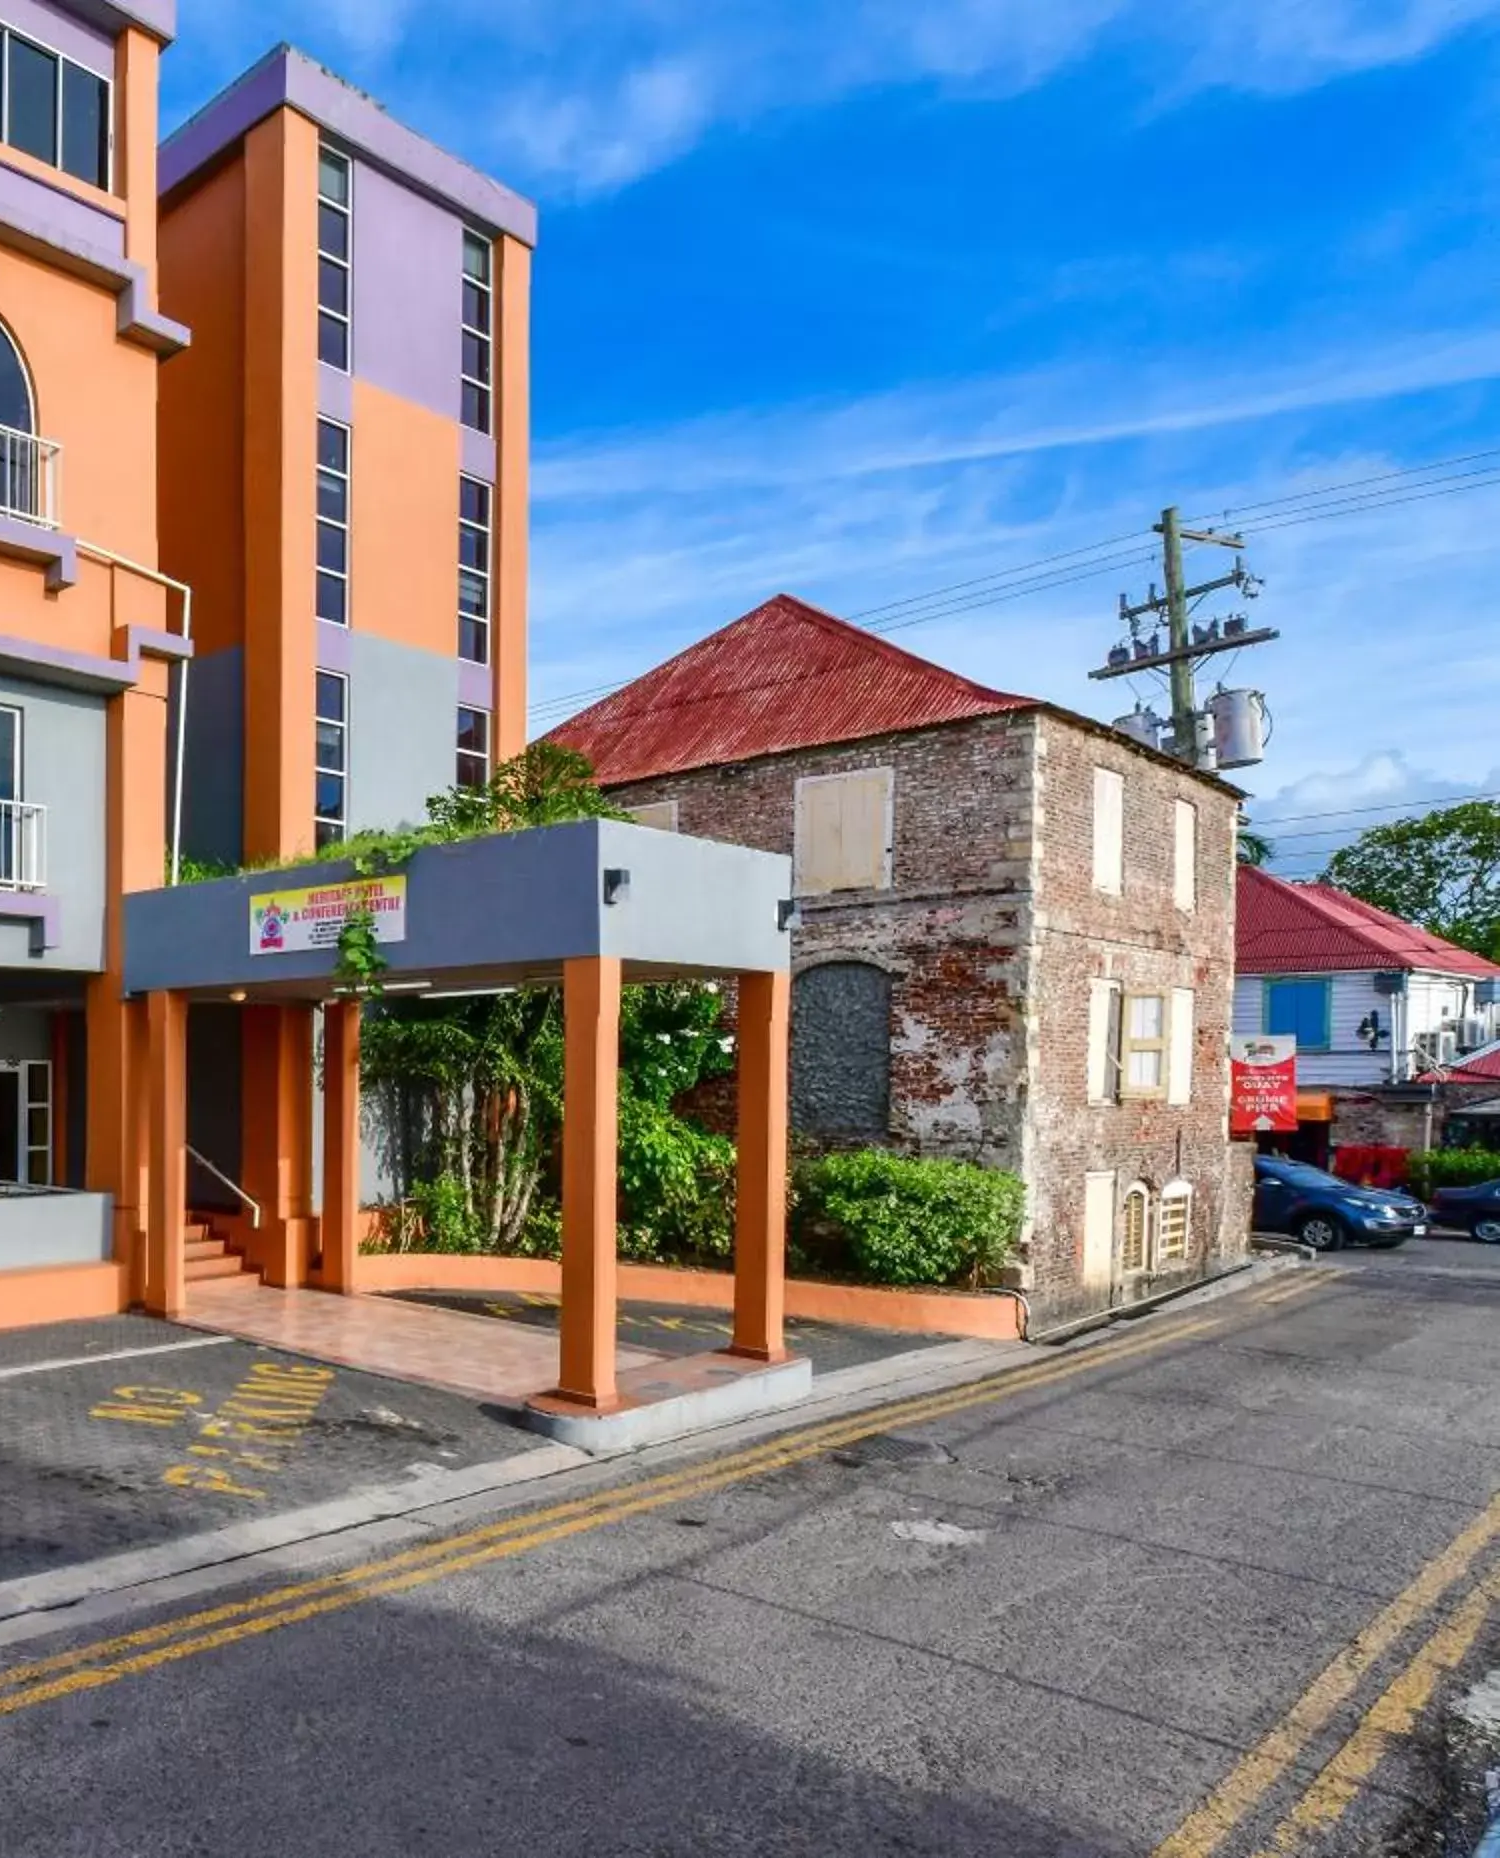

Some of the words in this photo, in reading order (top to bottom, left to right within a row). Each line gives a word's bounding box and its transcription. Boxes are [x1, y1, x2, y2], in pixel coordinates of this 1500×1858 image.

[363, 896, 400, 913] ENTRE
[1243, 1081, 1281, 1089] QUAY
[88, 1384, 203, 1429] NO
